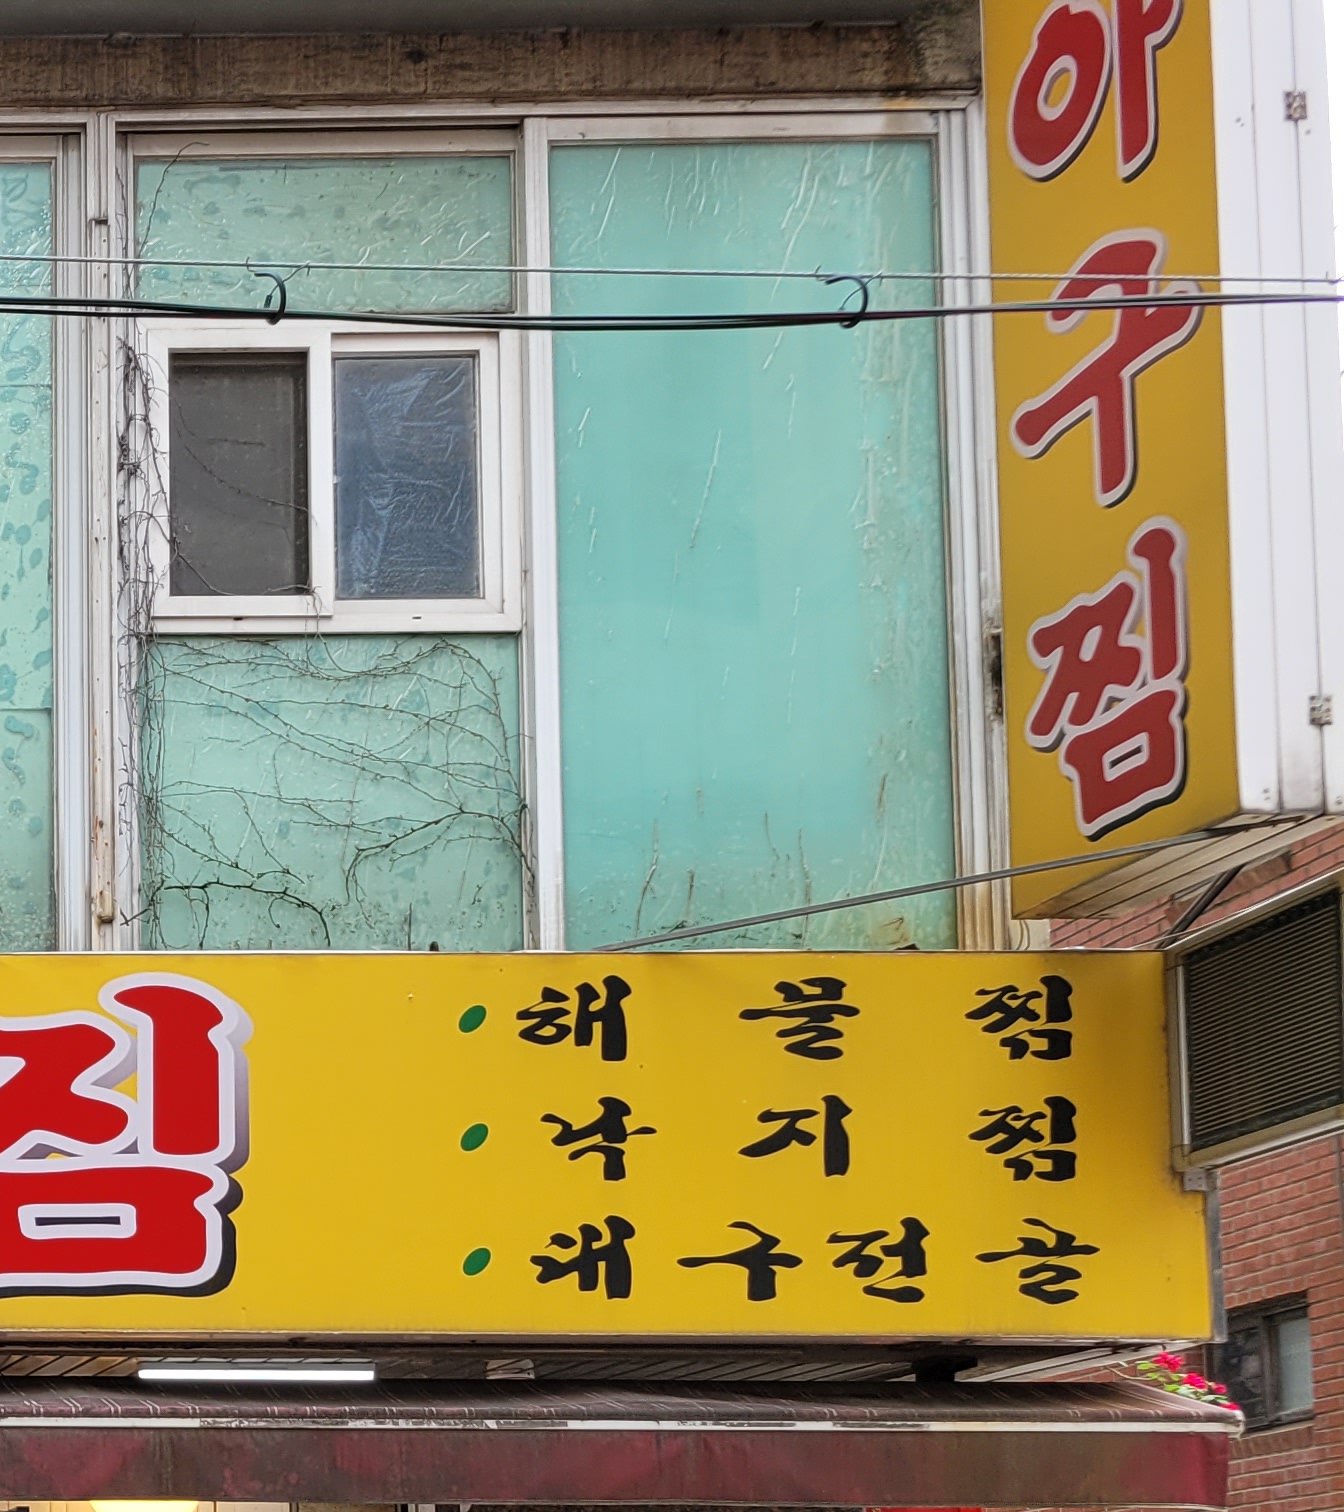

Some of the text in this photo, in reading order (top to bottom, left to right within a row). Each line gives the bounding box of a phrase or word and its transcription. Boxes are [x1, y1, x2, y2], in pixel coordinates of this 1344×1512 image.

[1008, 0, 1202, 839] 아구찜
[515, 974, 1074, 1061] 해물찜
[540, 1095, 1077, 1181] 낙지찜
[529, 1215, 1101, 1304] 대구전골
